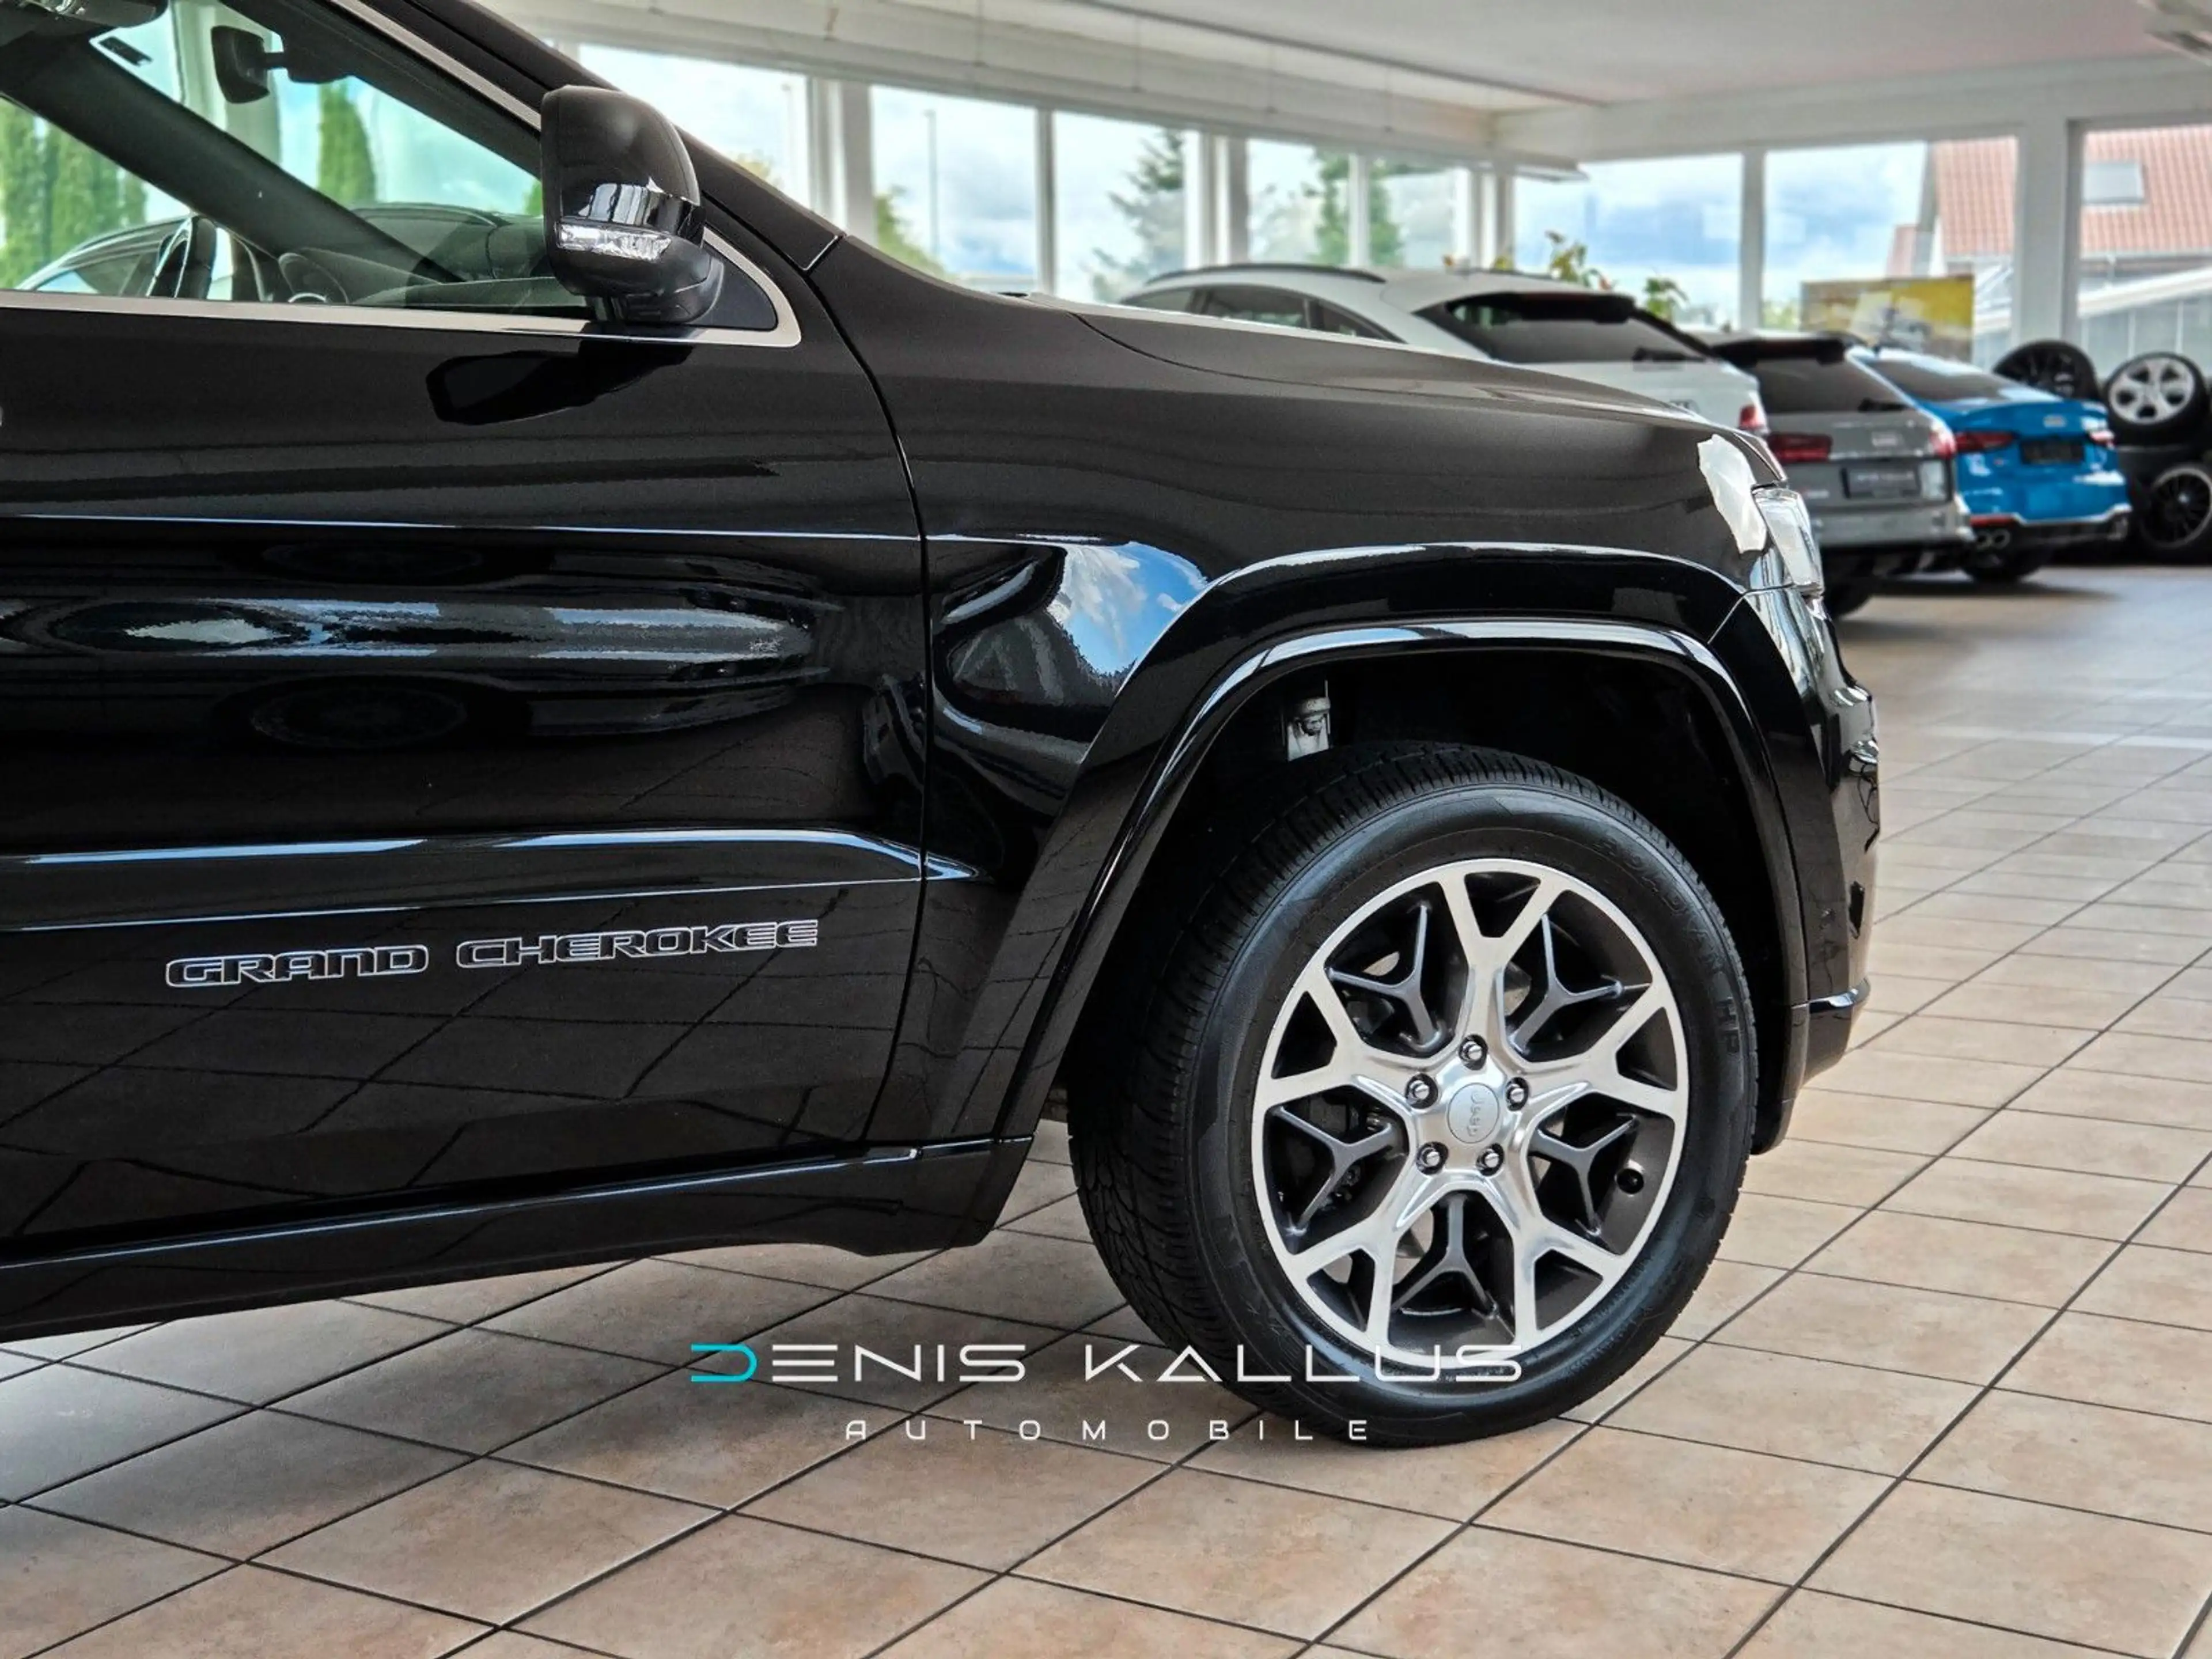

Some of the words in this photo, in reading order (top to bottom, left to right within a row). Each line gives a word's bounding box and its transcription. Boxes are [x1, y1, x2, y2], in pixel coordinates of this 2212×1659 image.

[166, 944, 429, 987] GRAND
[457, 919, 818, 969] CHEROKEE
[1466, 1091, 1486, 1137] Jeep
